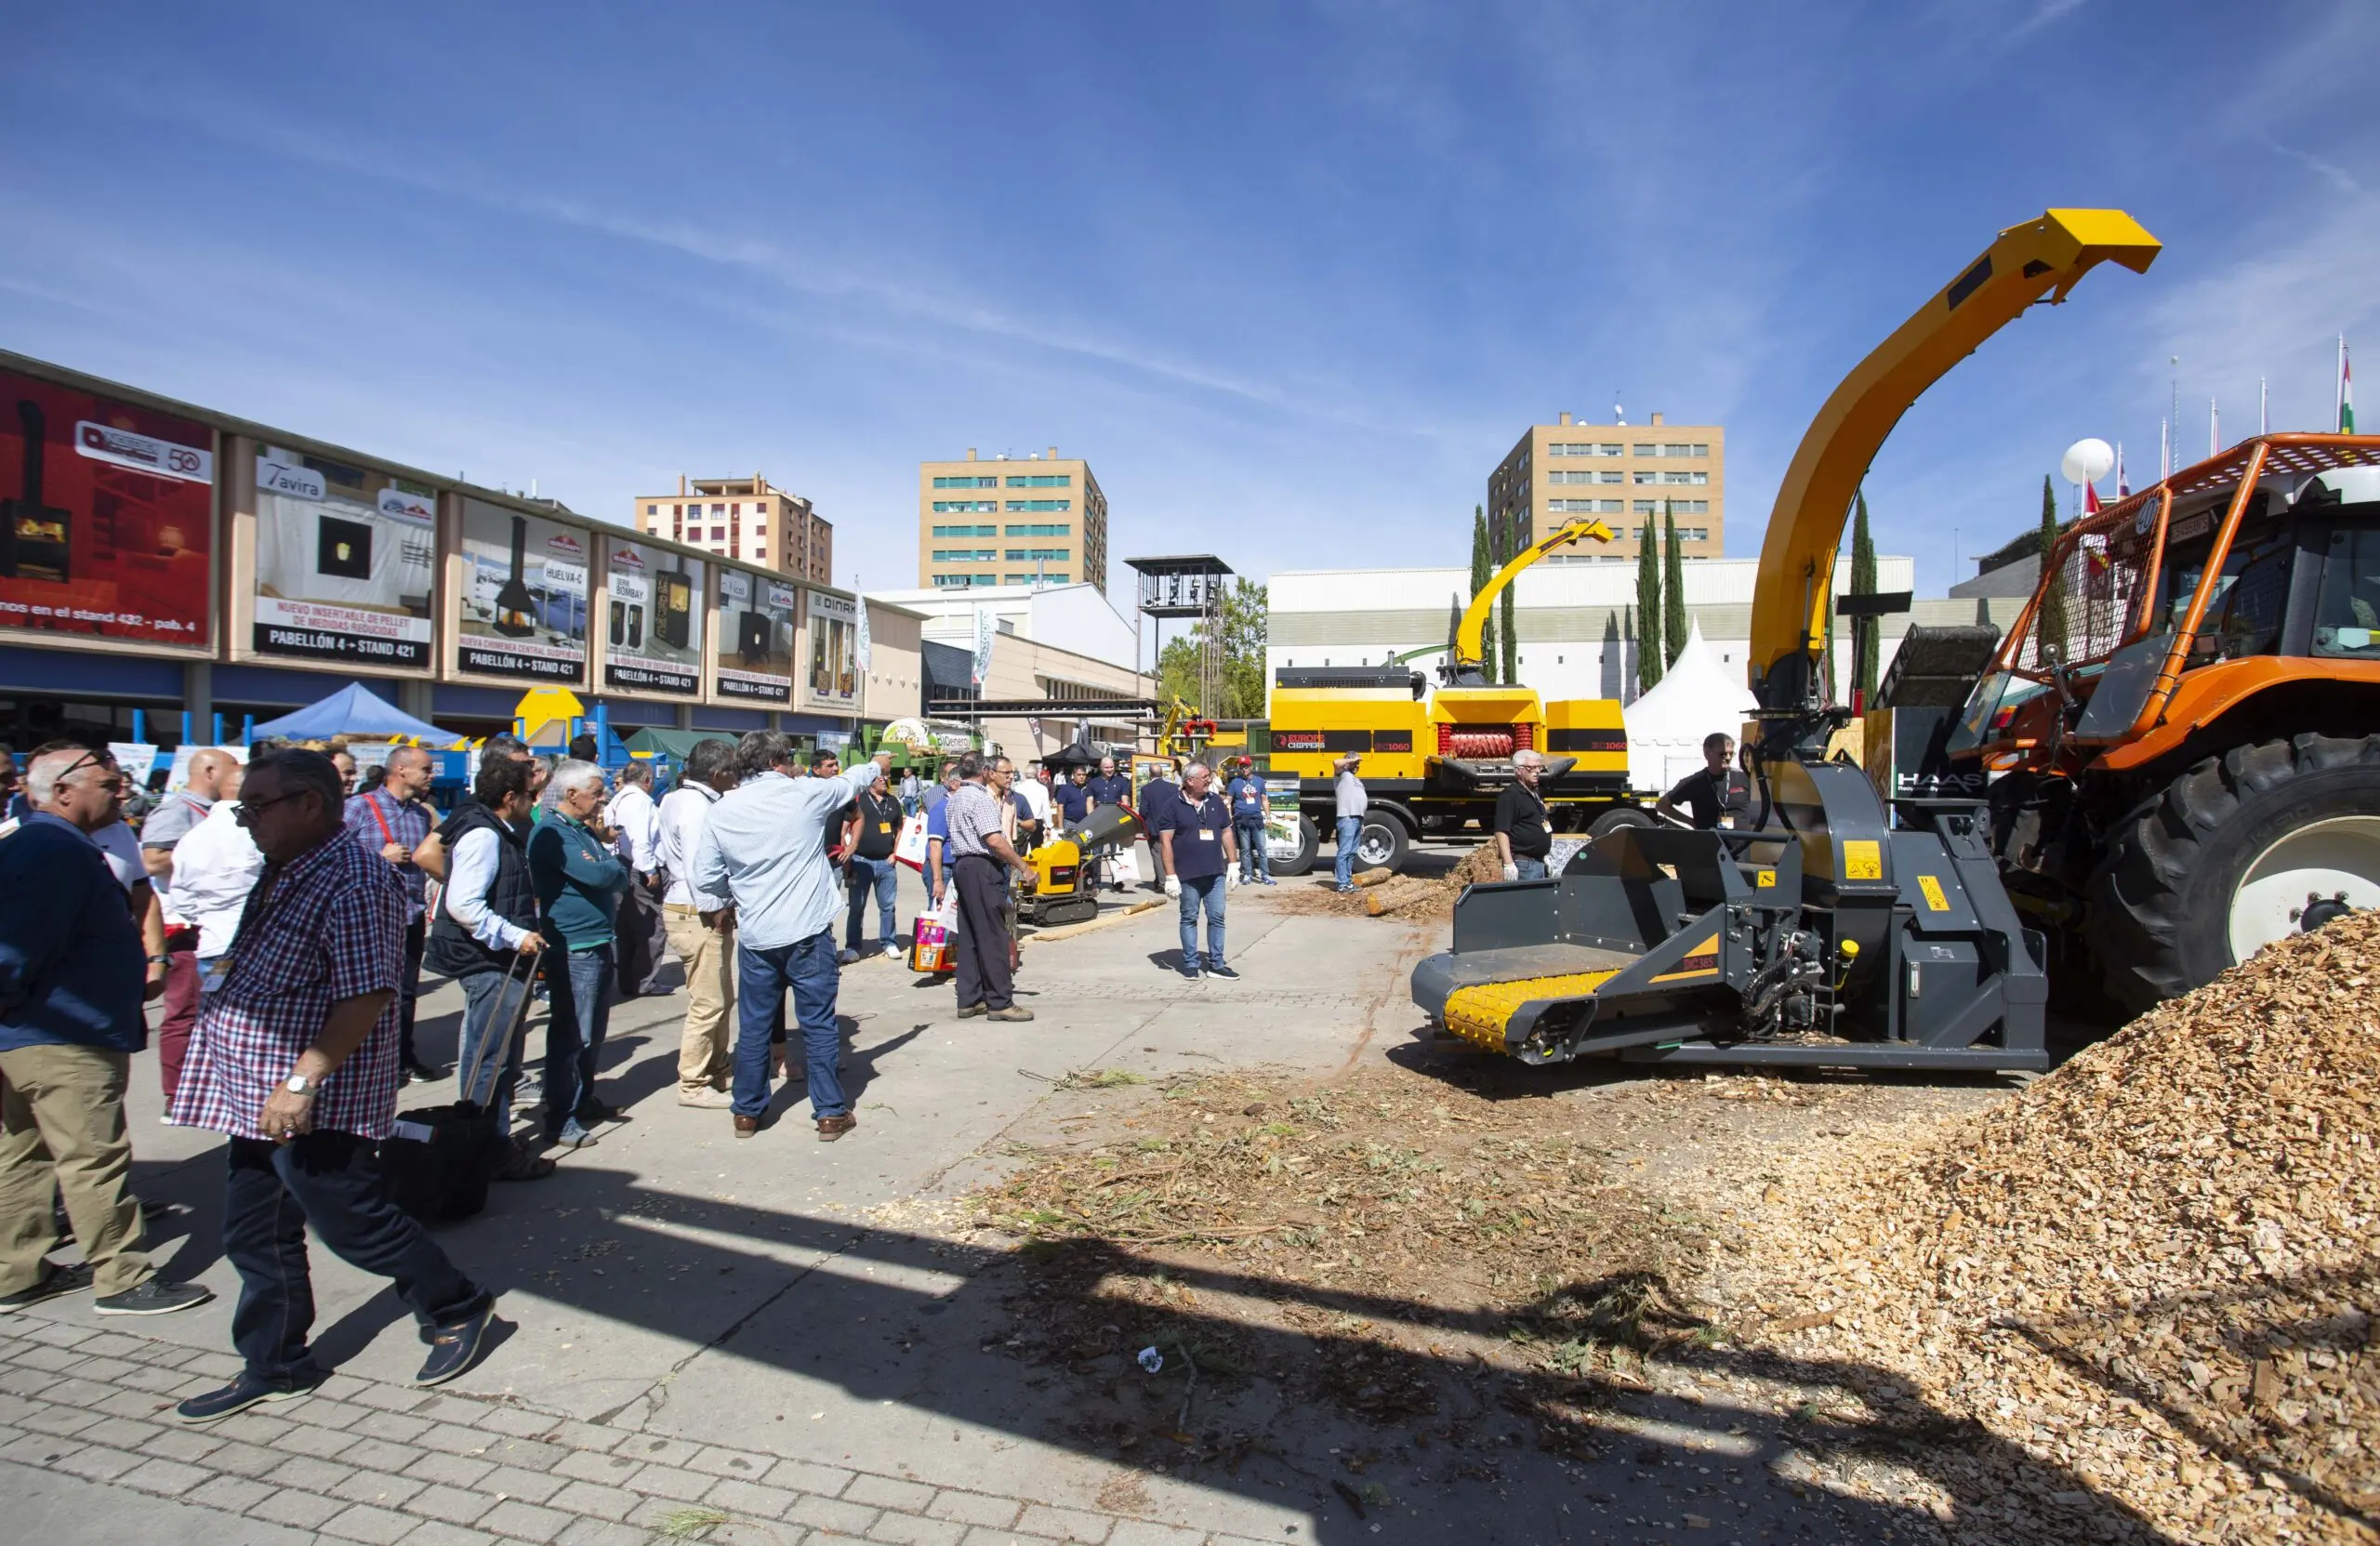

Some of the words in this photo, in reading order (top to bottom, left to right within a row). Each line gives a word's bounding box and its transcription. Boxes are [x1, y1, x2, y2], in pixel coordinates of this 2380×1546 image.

[266, 463, 319, 496] Tavira
[547, 568, 582, 584] HUELVA-C
[617, 578, 630, 587] SERIE
[616, 586, 643, 600] BOMBAY
[31, 604, 52, 615] en
[55, 607, 71, 617] el
[73, 610, 115, 623] stand
[118, 614, 143, 626] 432
[154, 619, 184, 630] pab.
[186, 621, 195, 632] 4
[278, 602, 310, 614] NUEVO
[312, 606, 365, 621] INSERTABLE
[367, 614, 378, 623] DE
[380, 616, 409, 628] PELLET
[293, 615, 305, 626] DE
[309, 617, 349, 630] MEDIDAS
[350, 622, 398, 637] REDUCIDAS
[270, 628, 335, 650] PABELLÓN
[337, 638, 345, 650] 4
[358, 640, 393, 655] STAND
[395, 645, 415, 657] 421
[484, 639, 516, 652] CHIMENEA
[519, 643, 545, 655] CENTRAL
[470, 652, 515, 668] PABELLÓN
[517, 660, 522, 669] 4
[532, 660, 558, 673] STAND
[560, 663, 574, 675] 421
[615, 668, 647, 682] PABELLÓN
[648, 674, 654, 683] 4
[659, 674, 679, 686] STAND
[681, 678, 691, 687] 421
[723, 681, 748, 693] PABELLÓN
[759, 685, 774, 695] STAND
[775, 688, 784, 696] 421
[1897, 773, 1982, 792] HAAS
